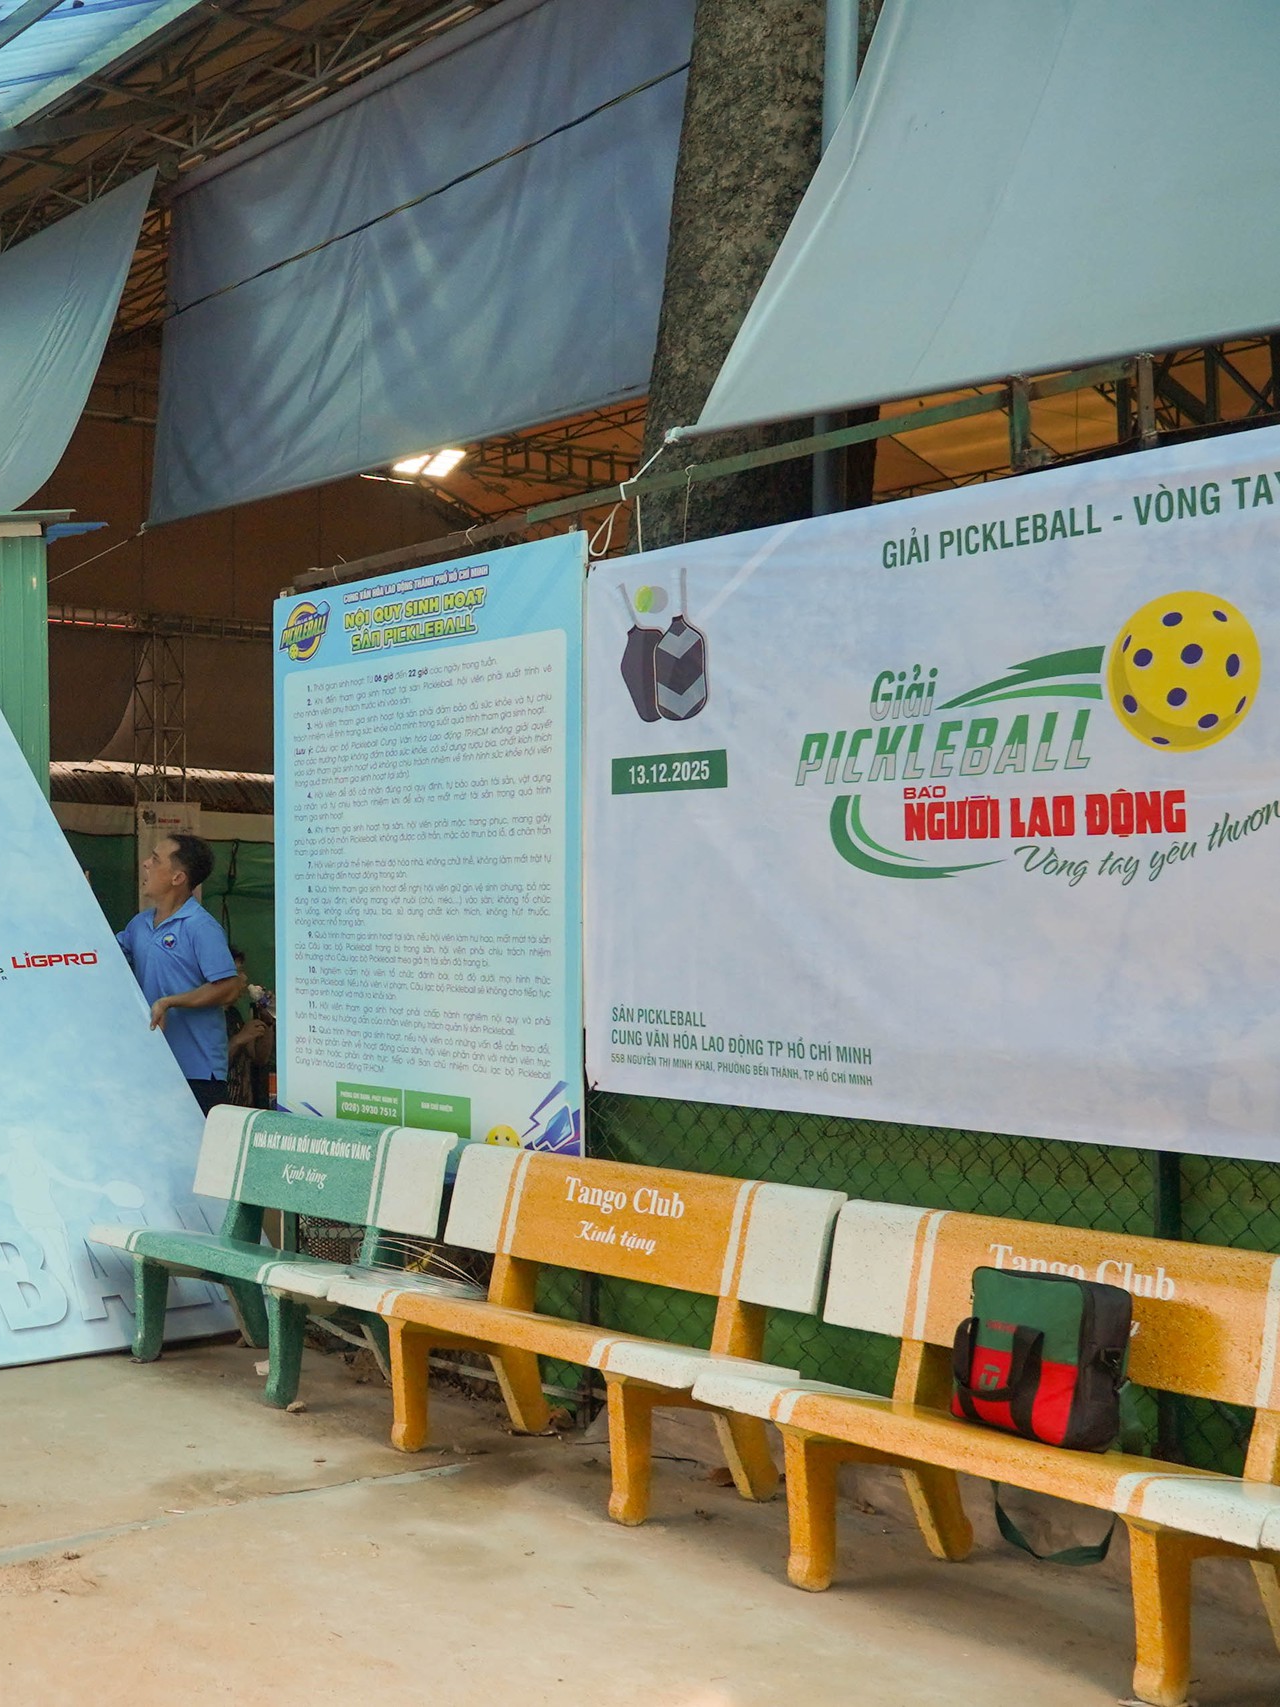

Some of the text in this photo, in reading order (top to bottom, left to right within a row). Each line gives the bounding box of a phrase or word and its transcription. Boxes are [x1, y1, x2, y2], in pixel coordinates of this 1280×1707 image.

[882, 527, 930, 569] GIẢI
[939, 504, 1102, 559] PICKLEBALL
[1133, 483, 1220, 525] VÒNG
[1231, 471, 1280, 510] TA
[344, 587, 485, 630] NỘI QUY SINH HOẠT
[383, 614, 477, 646] PICKLEBALL
[374, 674, 382, 683] 06
[383, 671, 394, 683] giờ
[407, 669, 416, 677] 22
[417, 666, 428, 678] giờ
[869, 663, 938, 721] Giải
[795, 708, 1091, 786] PICKLEBALL
[628, 759, 710, 785] 13.12.2025
[903, 785, 947, 800] BÁO
[904, 788, 1186, 841] NGƯỜI LAO ĐỘNG
[1014, 844, 1088, 887] Vòng
[1098, 850, 1140, 886] tay
[1148, 840, 1197, 881] yêu
[611, 1003, 707, 1028] SÂN PICKLEBALL
[611, 1029, 642, 1046] CUNG
[645, 1029, 669, 1048] VĂN
[673, 1030, 698, 1050] HÓA
[701, 1035, 725, 1052] LAO
[728, 1034, 764, 1058] ĐỘNG
[767, 1040, 783, 1057] TP
[809, 1041, 832, 1062] CHÍ
[836, 1045, 872, 1065] MINH
[672, 1059, 693, 1070] MINH
[803, 1069, 814, 1080] TP
[848, 1074, 873, 1086] MINH
[361, 1104, 378, 1116] 3930
[379, 1106, 397, 1118] 7512
[266, 1132, 281, 1149] HÁT
[564, 1175, 685, 1219] Tango Club
[574, 1220, 657, 1255] Kính tặng
[1096, 1259, 1177, 1301] Club
